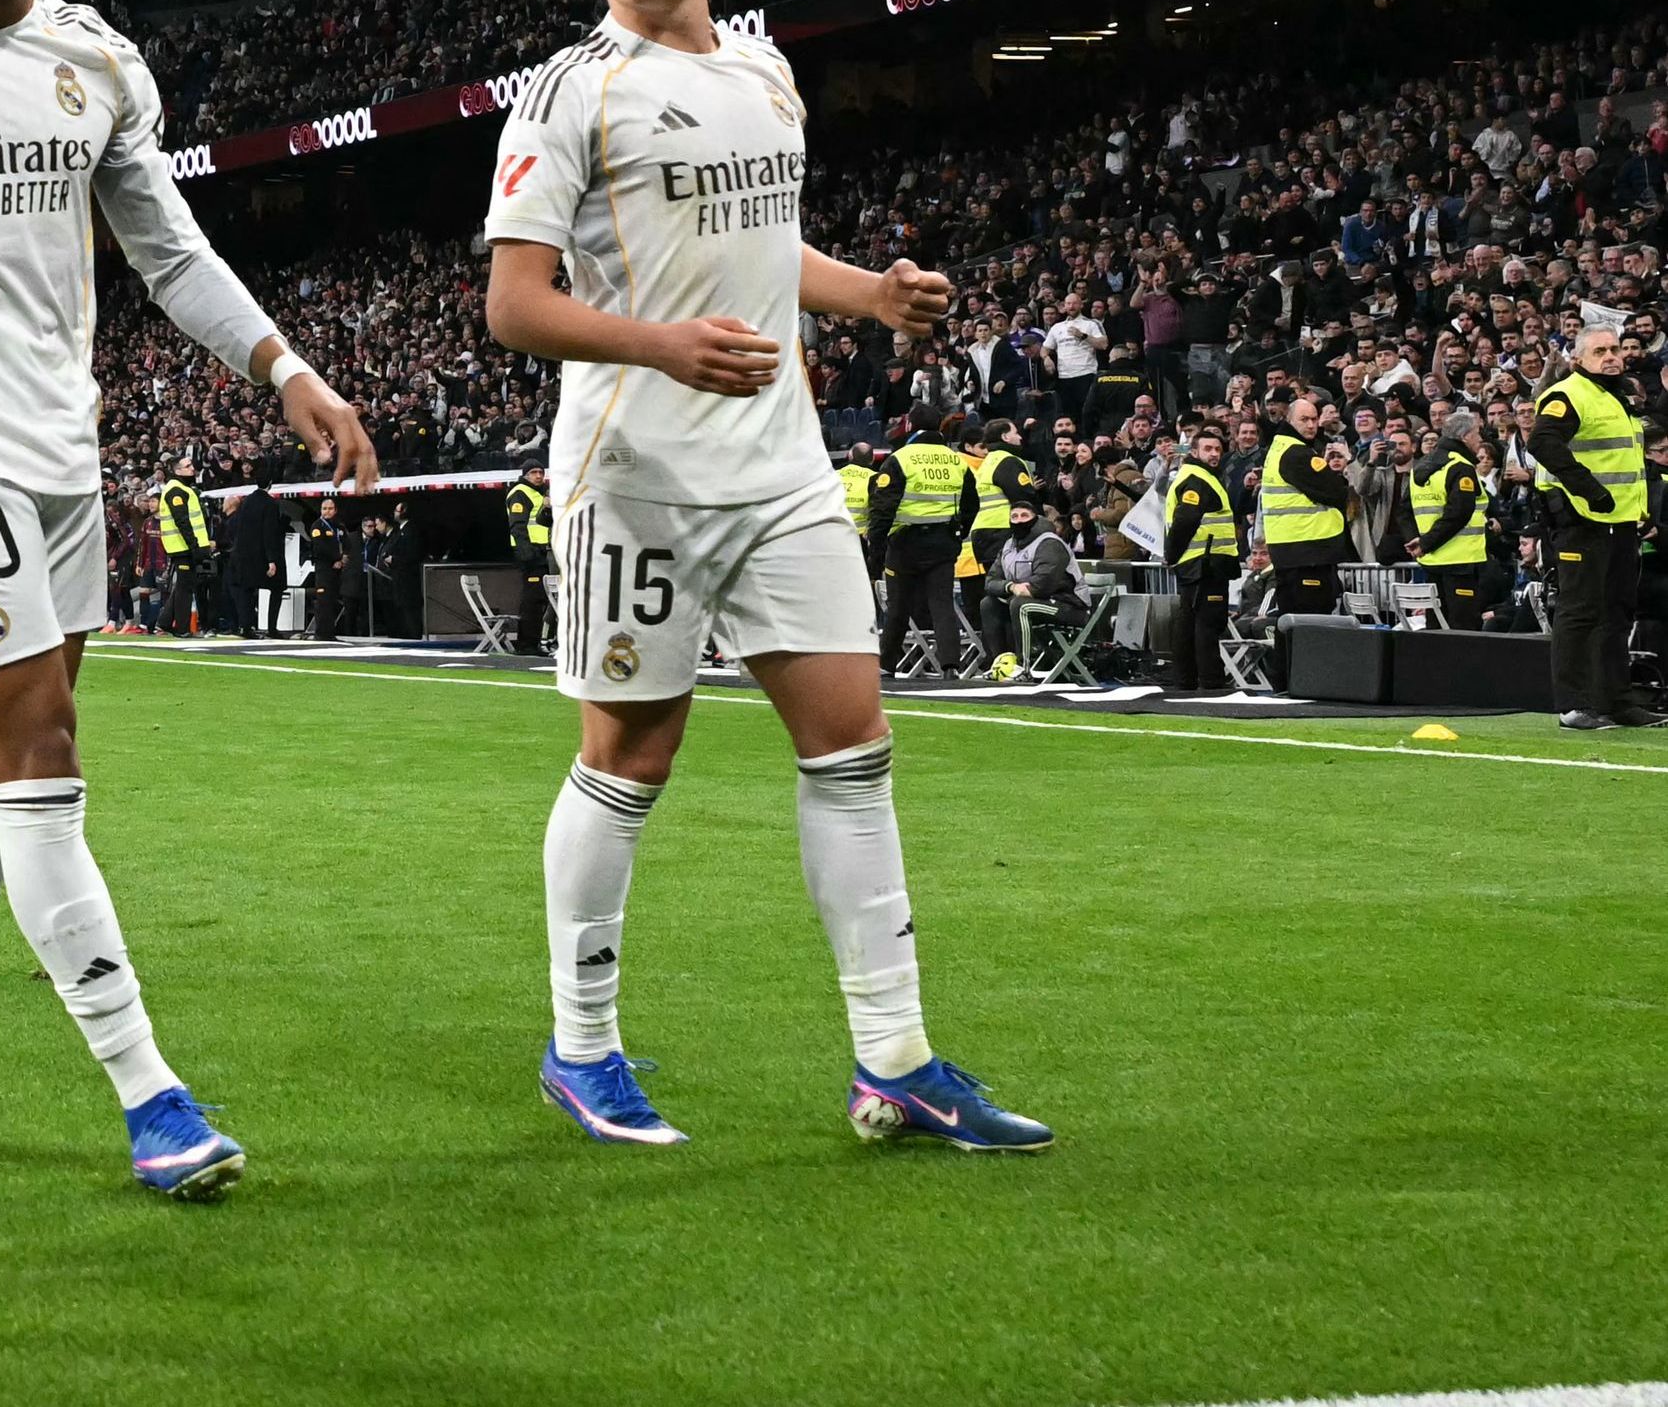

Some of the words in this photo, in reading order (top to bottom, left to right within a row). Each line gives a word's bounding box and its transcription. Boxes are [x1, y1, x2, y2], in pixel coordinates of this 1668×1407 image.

[661, 150, 806, 201] Emirates
[2, 179, 70, 216] BETTER
[698, 202, 731, 236] FLY
[741, 191, 796, 228] BETTER
[910, 454, 961, 466] SEGURIDAD
[922, 468, 950, 480] 1008
[601, 543, 676, 626] 15
